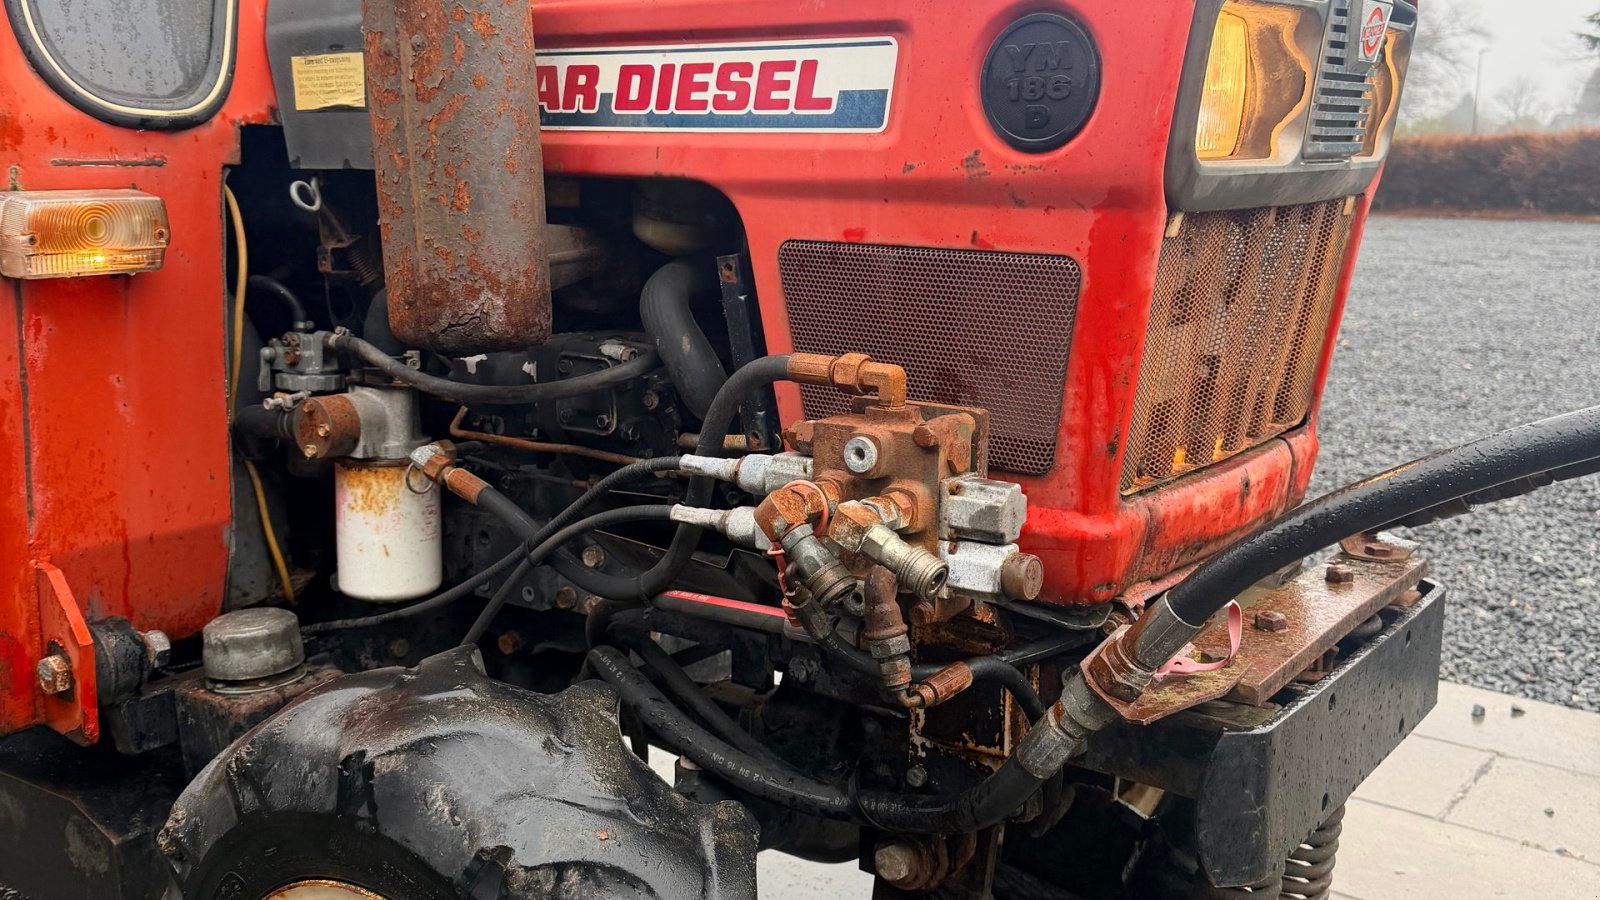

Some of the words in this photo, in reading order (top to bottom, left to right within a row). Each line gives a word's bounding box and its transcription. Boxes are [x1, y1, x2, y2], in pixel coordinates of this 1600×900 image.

[1004, 41, 1072, 73] YM
[614, 59, 832, 111] DIESEL
[1007, 74, 1072, 102] 186
[1024, 104, 1050, 129] D
